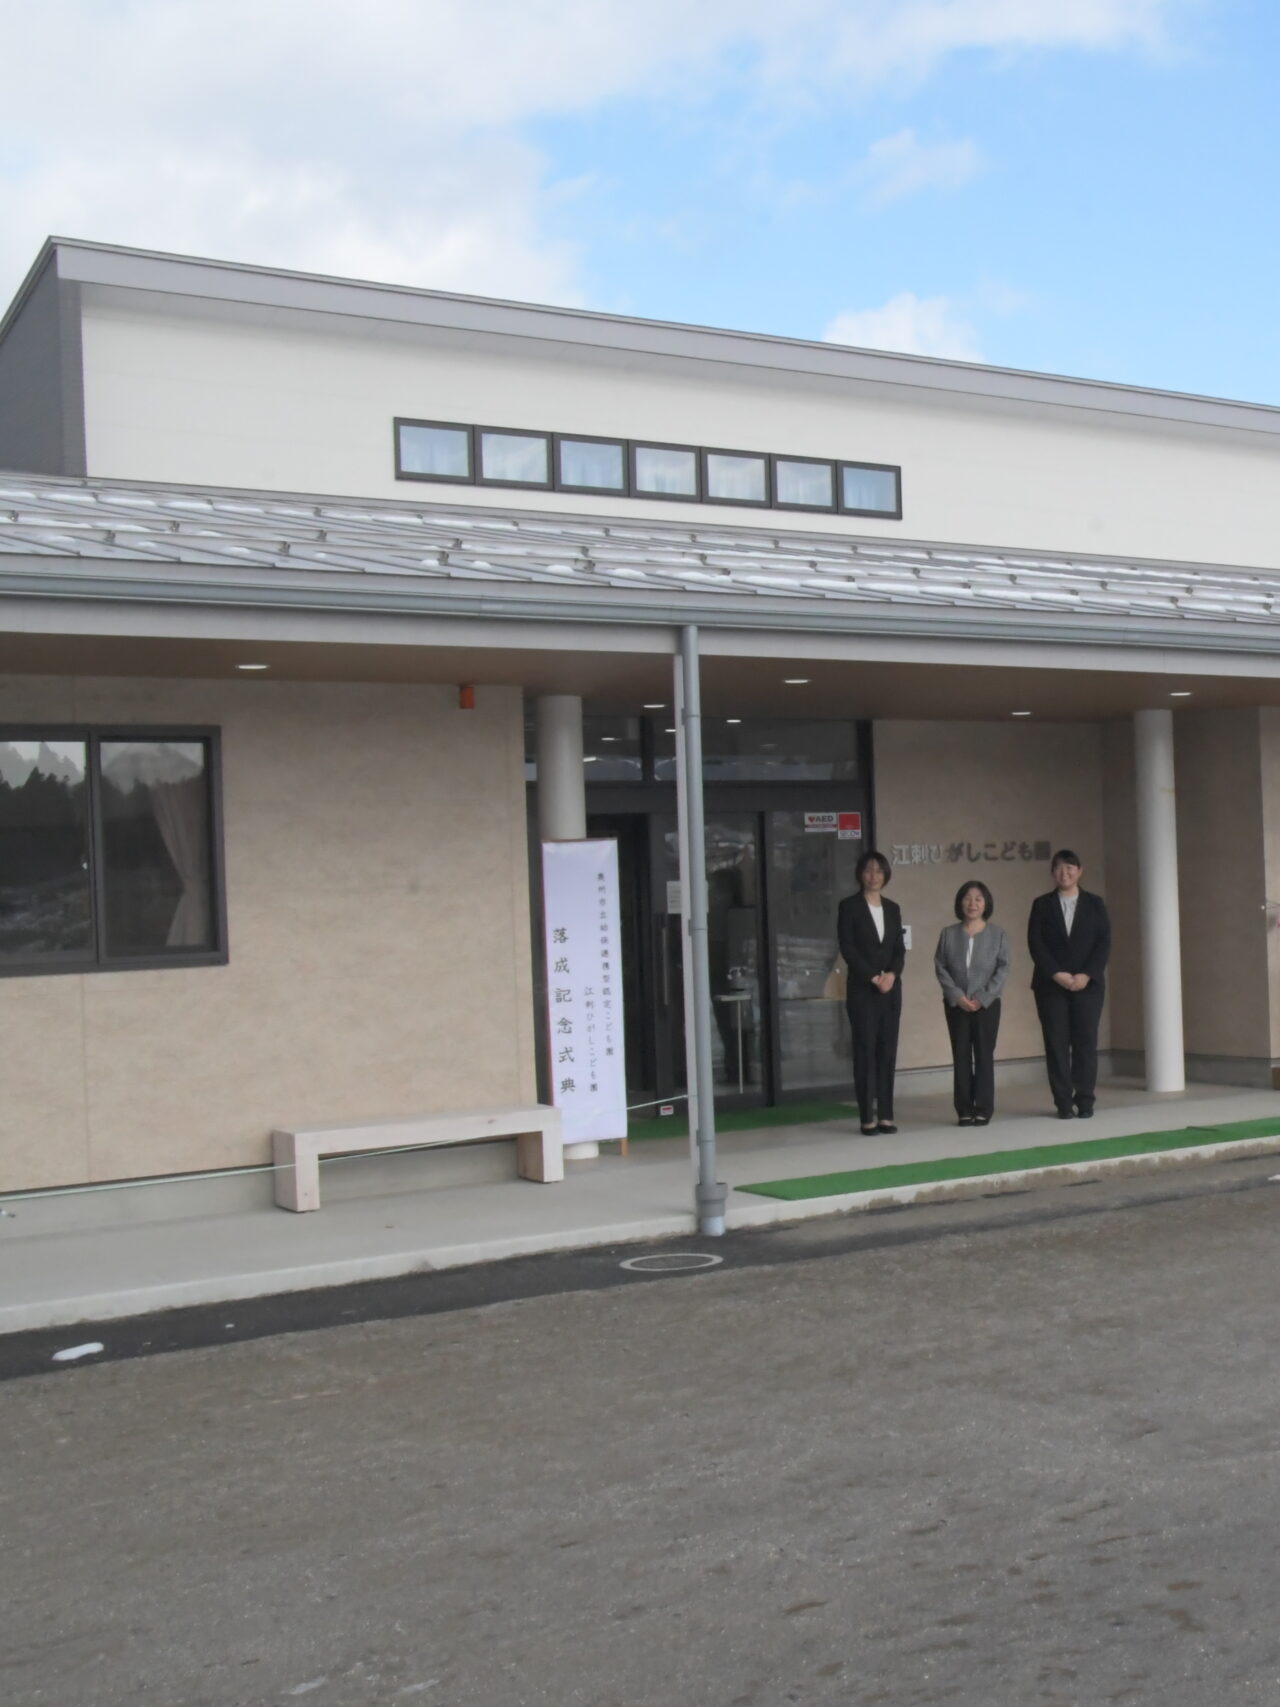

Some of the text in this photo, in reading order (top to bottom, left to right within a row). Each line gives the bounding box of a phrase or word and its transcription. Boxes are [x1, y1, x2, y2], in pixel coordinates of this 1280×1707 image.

[815, 815, 834, 823] AED
[552, 927, 576, 1094] 落成記念式典
